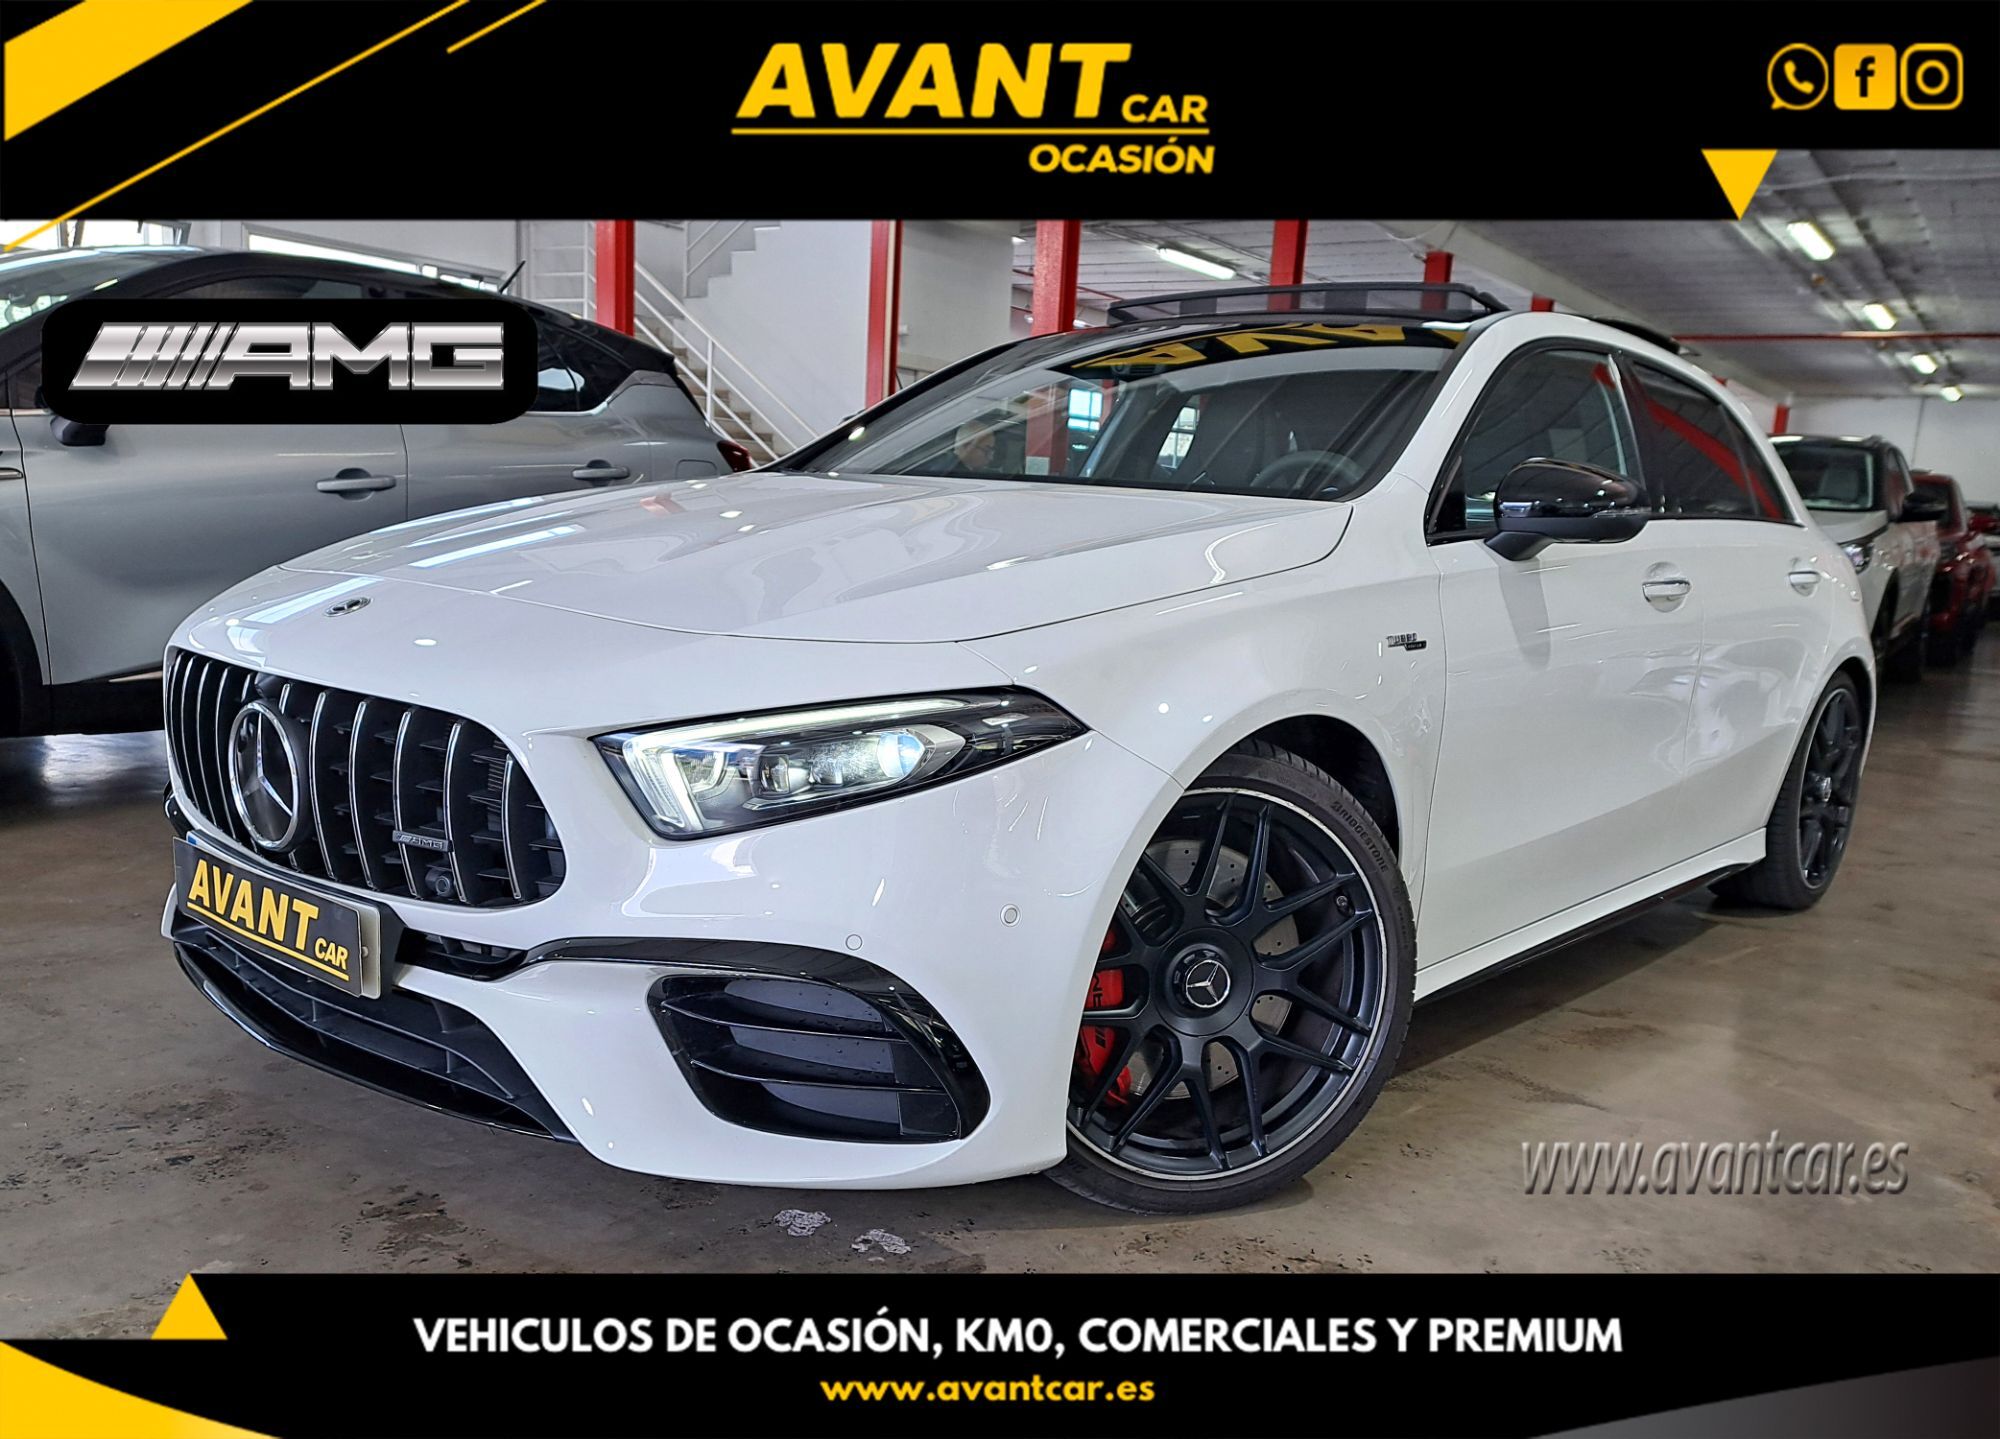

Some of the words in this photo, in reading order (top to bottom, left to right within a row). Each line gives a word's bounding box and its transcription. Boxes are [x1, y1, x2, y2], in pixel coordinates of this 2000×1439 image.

[1331, 801, 1389, 873] BRIDGESTONE
[188, 859, 320, 951] AVANT
[315, 937, 349, 970] CAR
